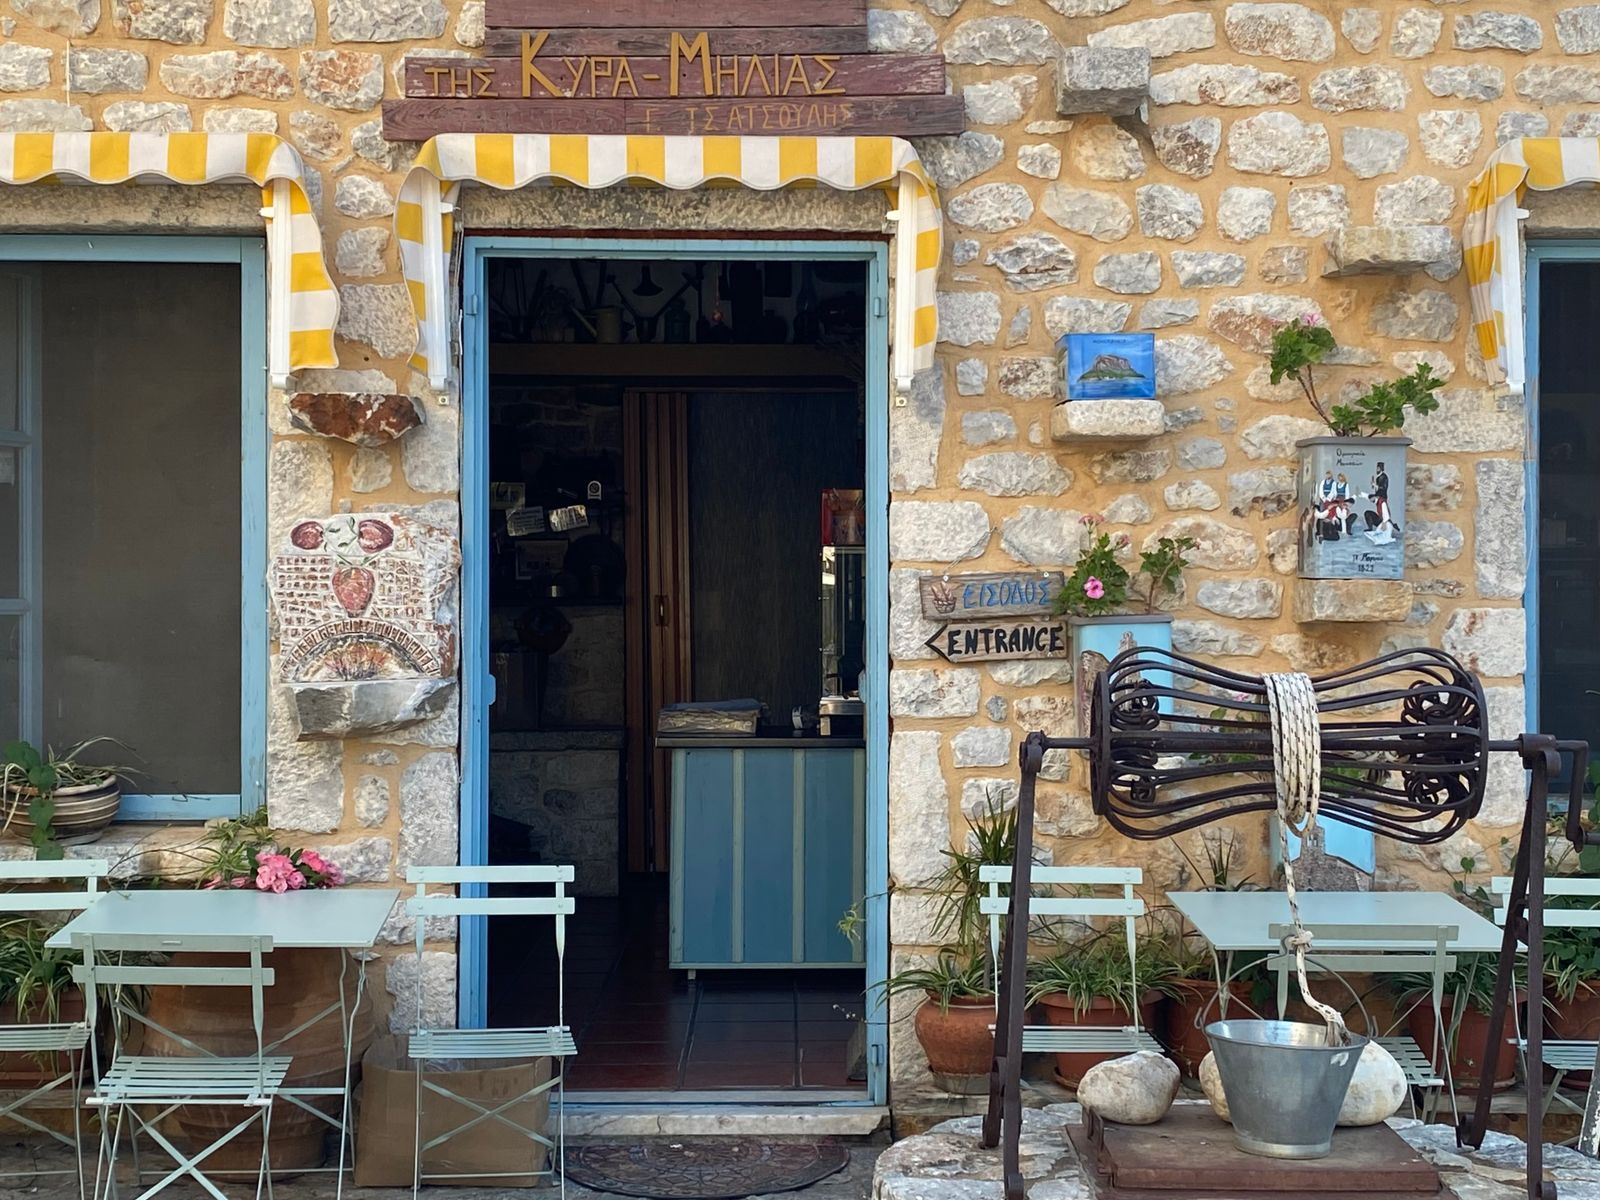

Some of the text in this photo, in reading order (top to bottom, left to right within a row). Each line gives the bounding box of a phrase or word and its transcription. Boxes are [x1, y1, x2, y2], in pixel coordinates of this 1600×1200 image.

[424, 67, 499, 97] ΤΗΣ
[962, 579, 1051, 609] ΕΙΣΟΔΟΣ
[947, 625, 1065, 657] ENTRANCE
